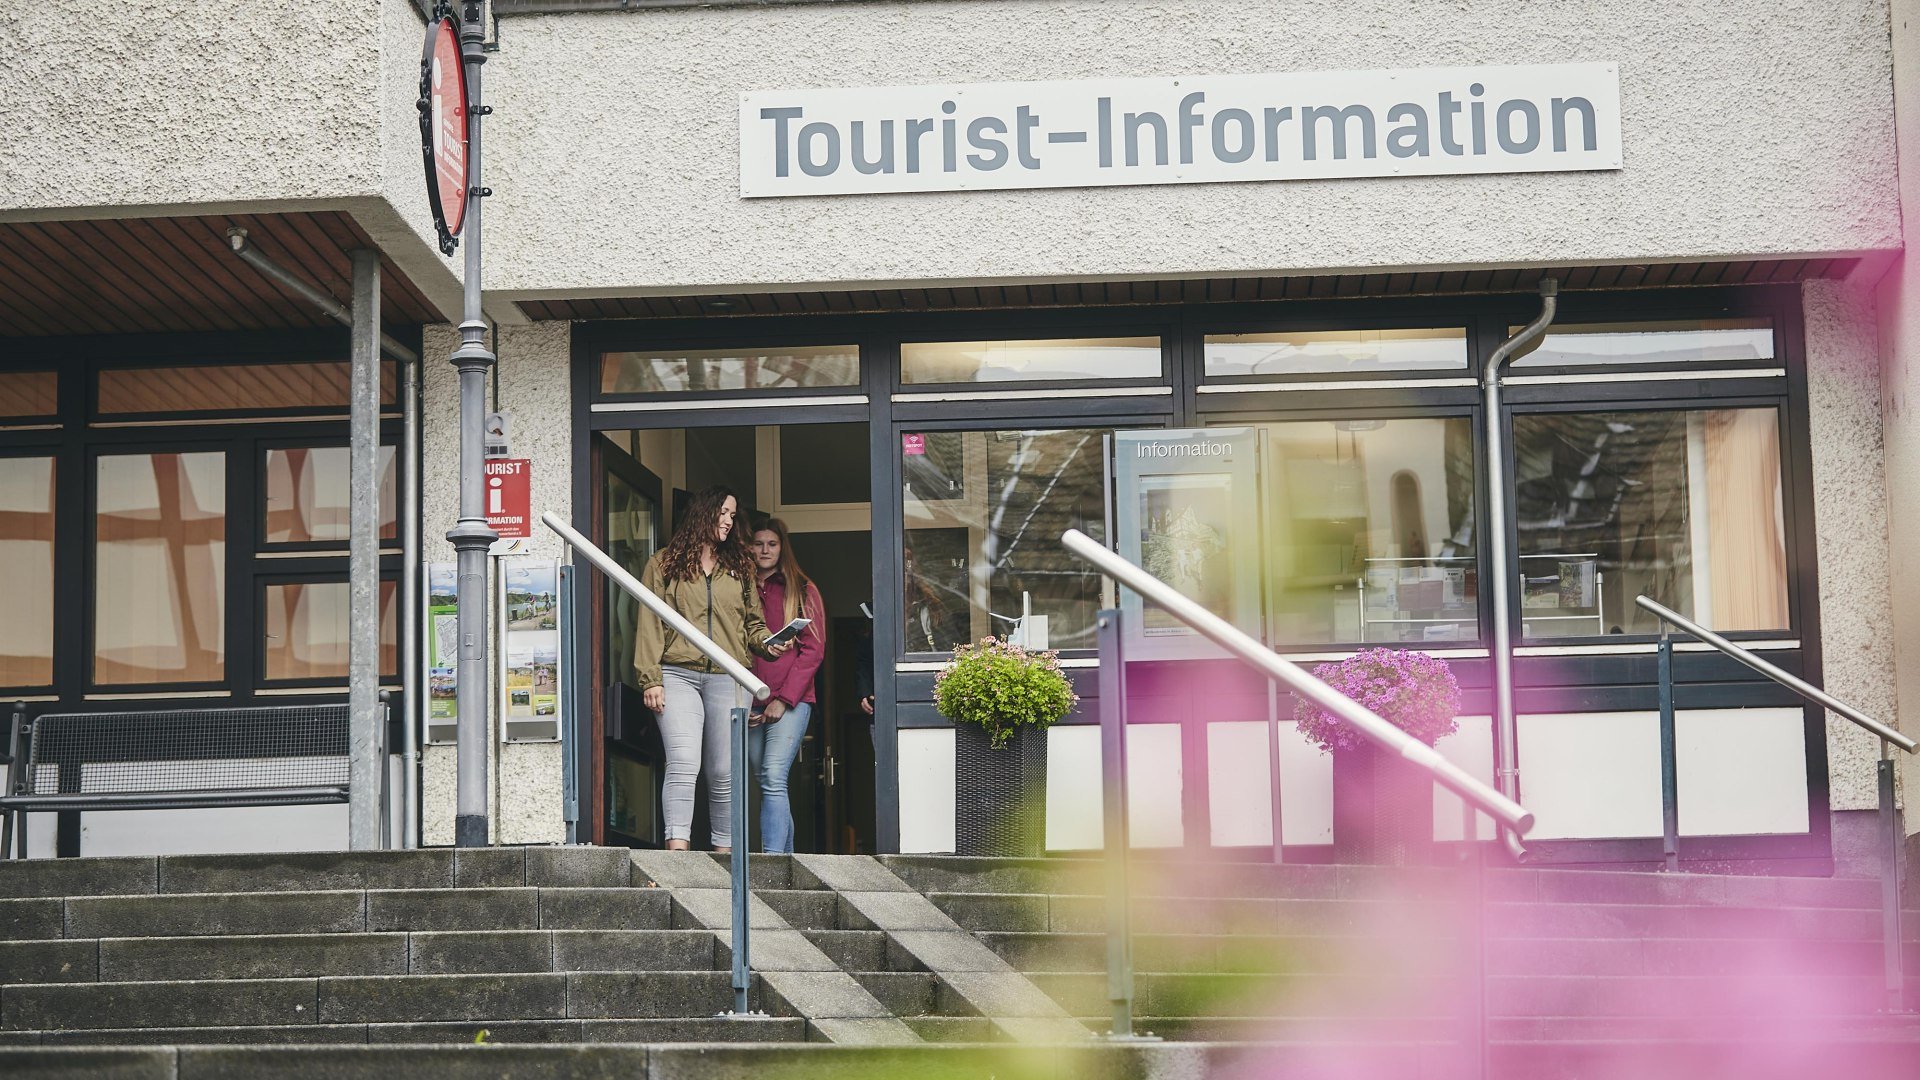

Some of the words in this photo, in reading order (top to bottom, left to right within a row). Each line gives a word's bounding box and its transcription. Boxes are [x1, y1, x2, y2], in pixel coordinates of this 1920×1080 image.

[760, 82, 1598, 178] Tourist-Information
[443, 129, 463, 162] TOURIST
[1137, 440, 1233, 458] Information
[485, 462, 522, 475] URIST
